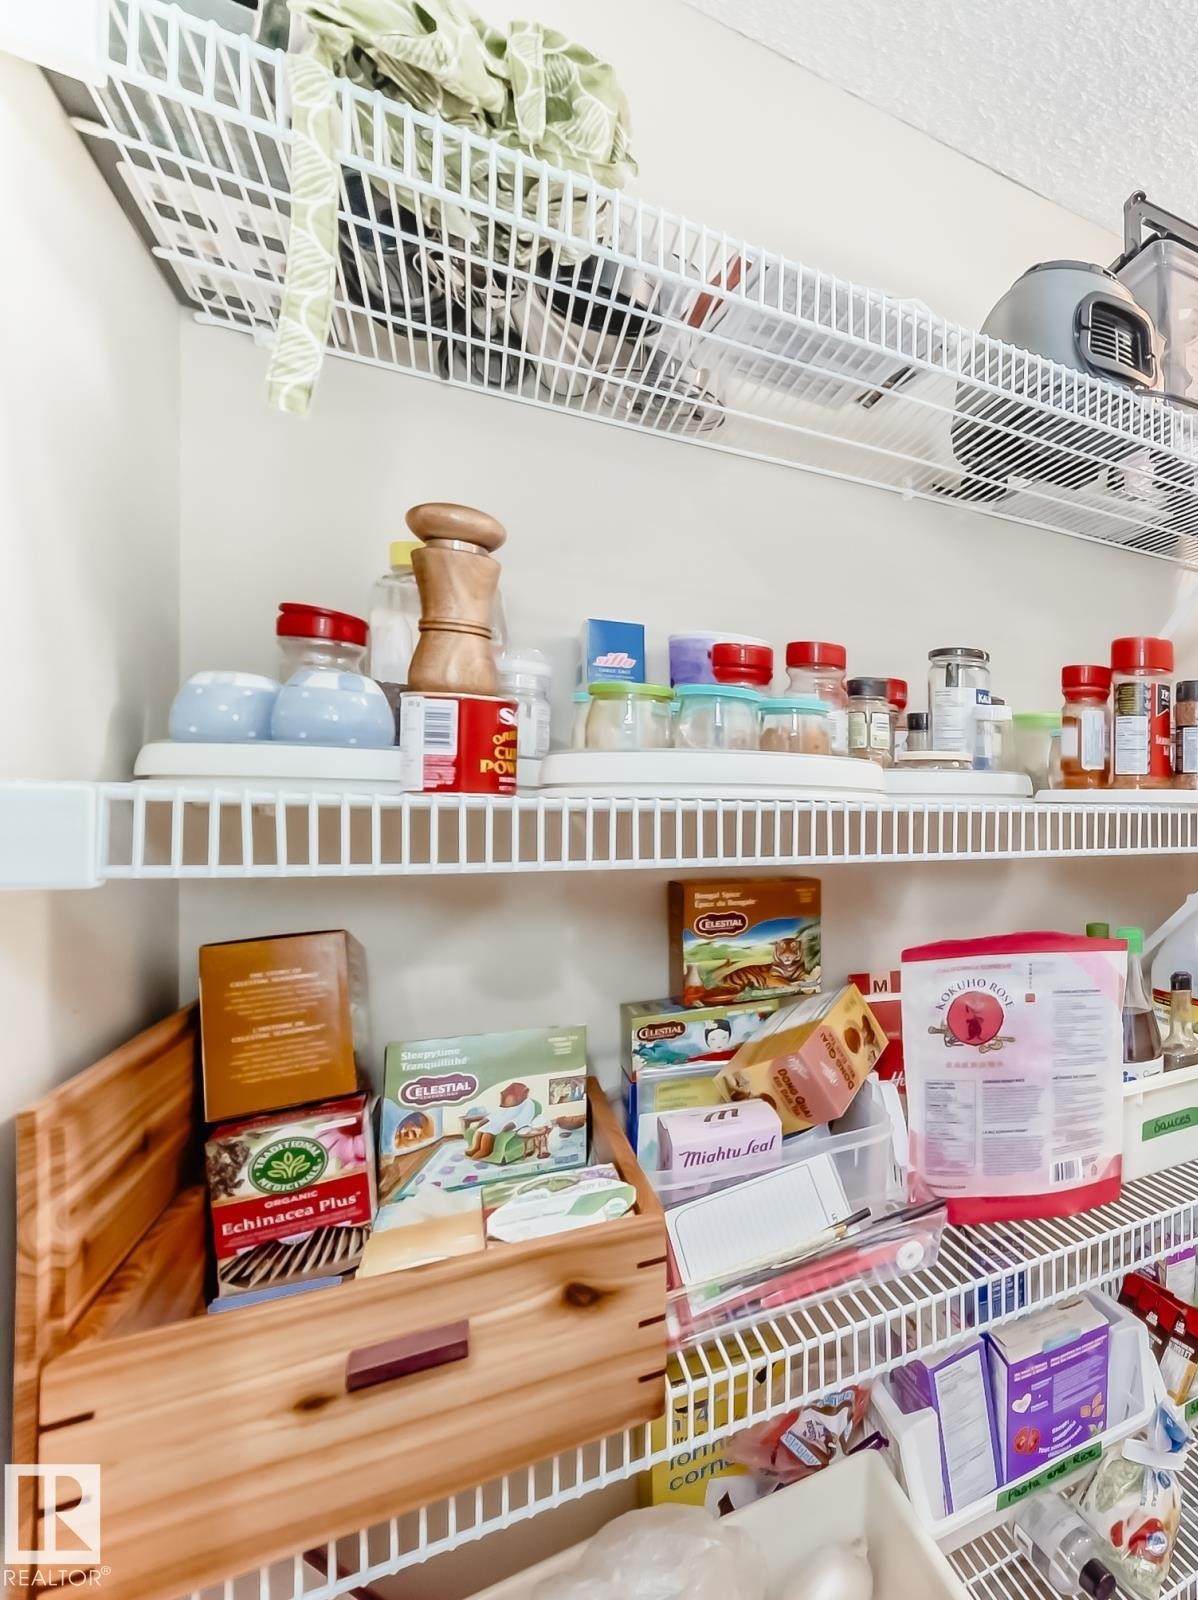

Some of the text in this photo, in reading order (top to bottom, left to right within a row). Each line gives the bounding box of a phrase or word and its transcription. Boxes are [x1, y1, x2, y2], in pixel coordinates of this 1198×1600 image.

[699, 919, 743, 931] CELESTIAL
[935, 979, 1015, 1010] KOKUHO ROSE
[639, 1027, 683, 1040] CELESTIAL
[401, 1048, 461, 1061] Sleepytime
[406, 1081, 471, 1099] CELESTIAL
[777, 1068, 813, 1118] DONG QUAI
[1154, 1113, 1191, 1134] Sauces
[254, 1140, 321, 1169] TRADITIONAL
[264, 1190, 318, 1209] ORGANIC
[222, 1205, 314, 1236] Echinacea
[1008, 1449, 1096, 1502] Pasta and Rice
